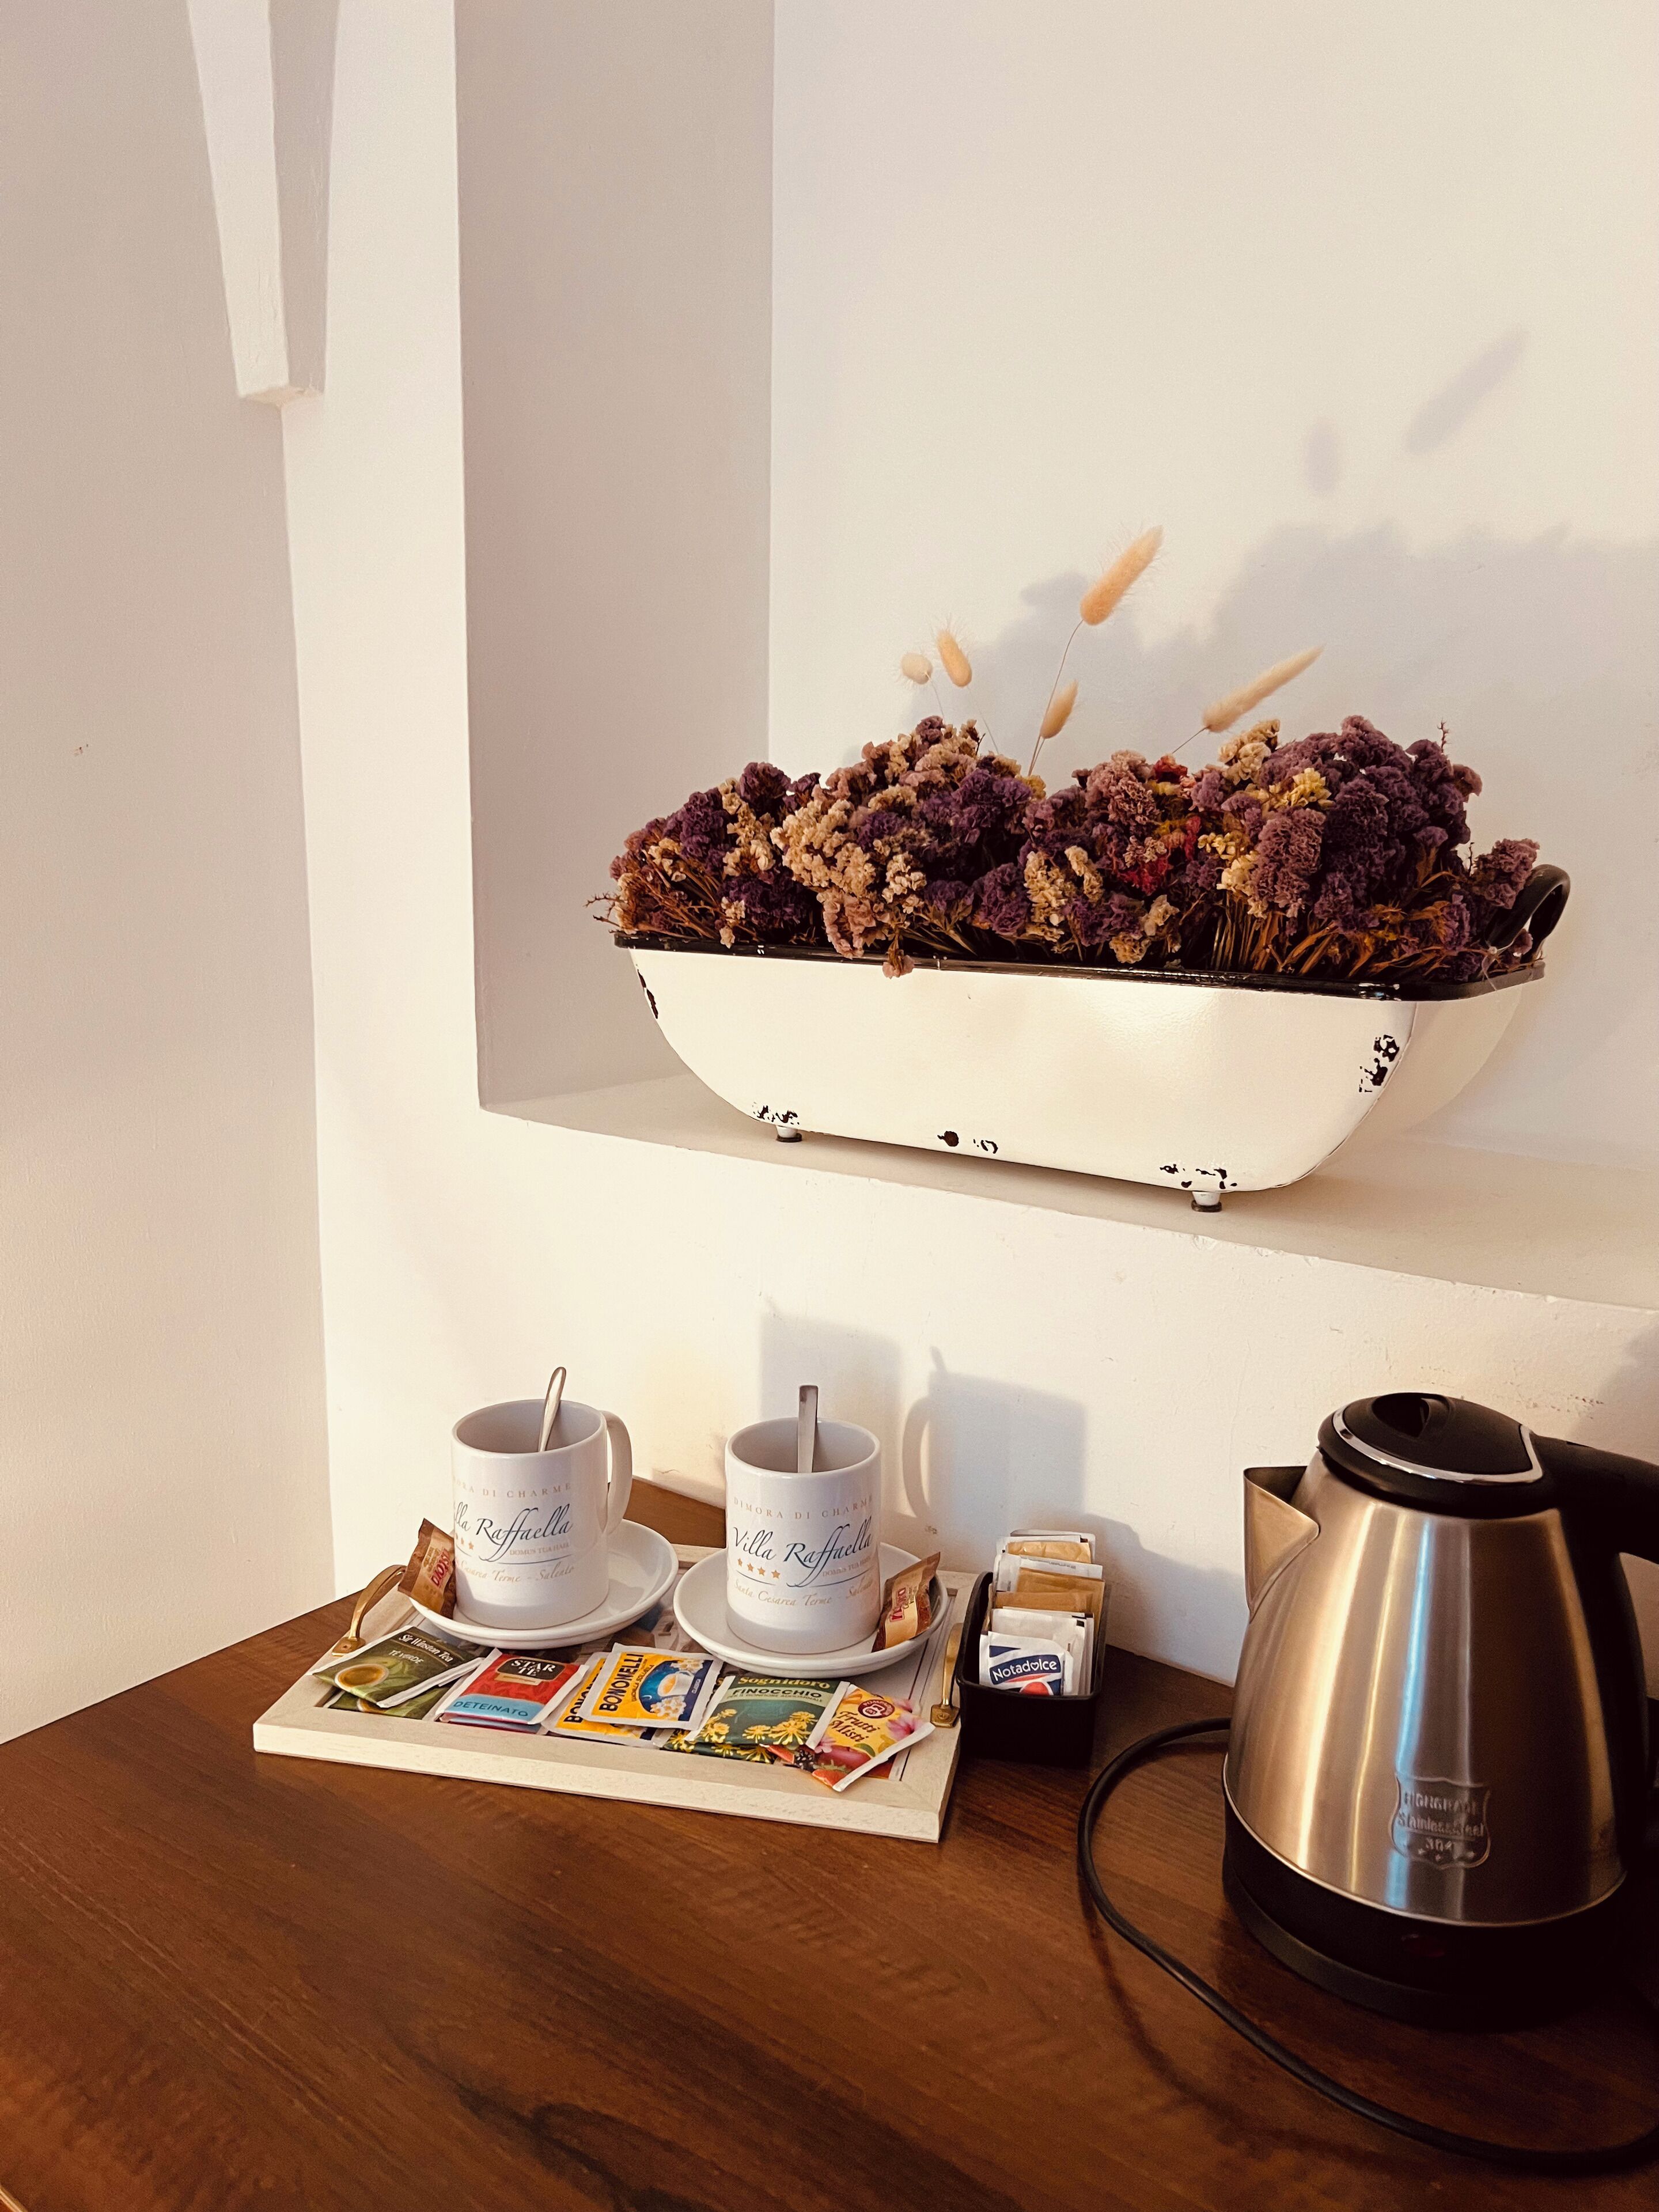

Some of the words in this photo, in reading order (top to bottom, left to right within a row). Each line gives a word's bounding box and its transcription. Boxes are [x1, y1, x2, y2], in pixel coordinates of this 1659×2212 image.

[483, 1488, 497, 1497] DI
[507, 1483, 571, 1498] CHARME
[733, 1496, 783, 1518] DIMORA
[795, 1512, 810, 1520] DI
[821, 1494, 873, 1518] CHARME
[453, 1501, 471, 1532] lla
[476, 1503, 574, 1562] Raffaella
[733, 1527, 777, 1560] Villa
[783, 1516, 874, 1588] Raffaella
[491, 1569, 521, 1583] Terme
[535, 1561, 576, 1581] Salento
[734, 1579, 755, 1599] Santa
[758, 1590, 797, 1607] Cesarea
[802, 1593, 832, 1607] Terme
[399, 1634, 414, 1642] Sir
[410, 1638, 441, 1654] Winston
[438, 1650, 454, 1663] Tea
[511, 1660, 556, 1672] STAR
[992, 1658, 1057, 1681] Notadolce
[733, 1688, 822, 1698] FINOCCHIO
[737, 1676, 831, 1689] Sognidoro
[453, 1701, 529, 1717] DETEINATO
[829, 1720, 869, 1742] Misti
[836, 1710, 881, 1733] Frutti
